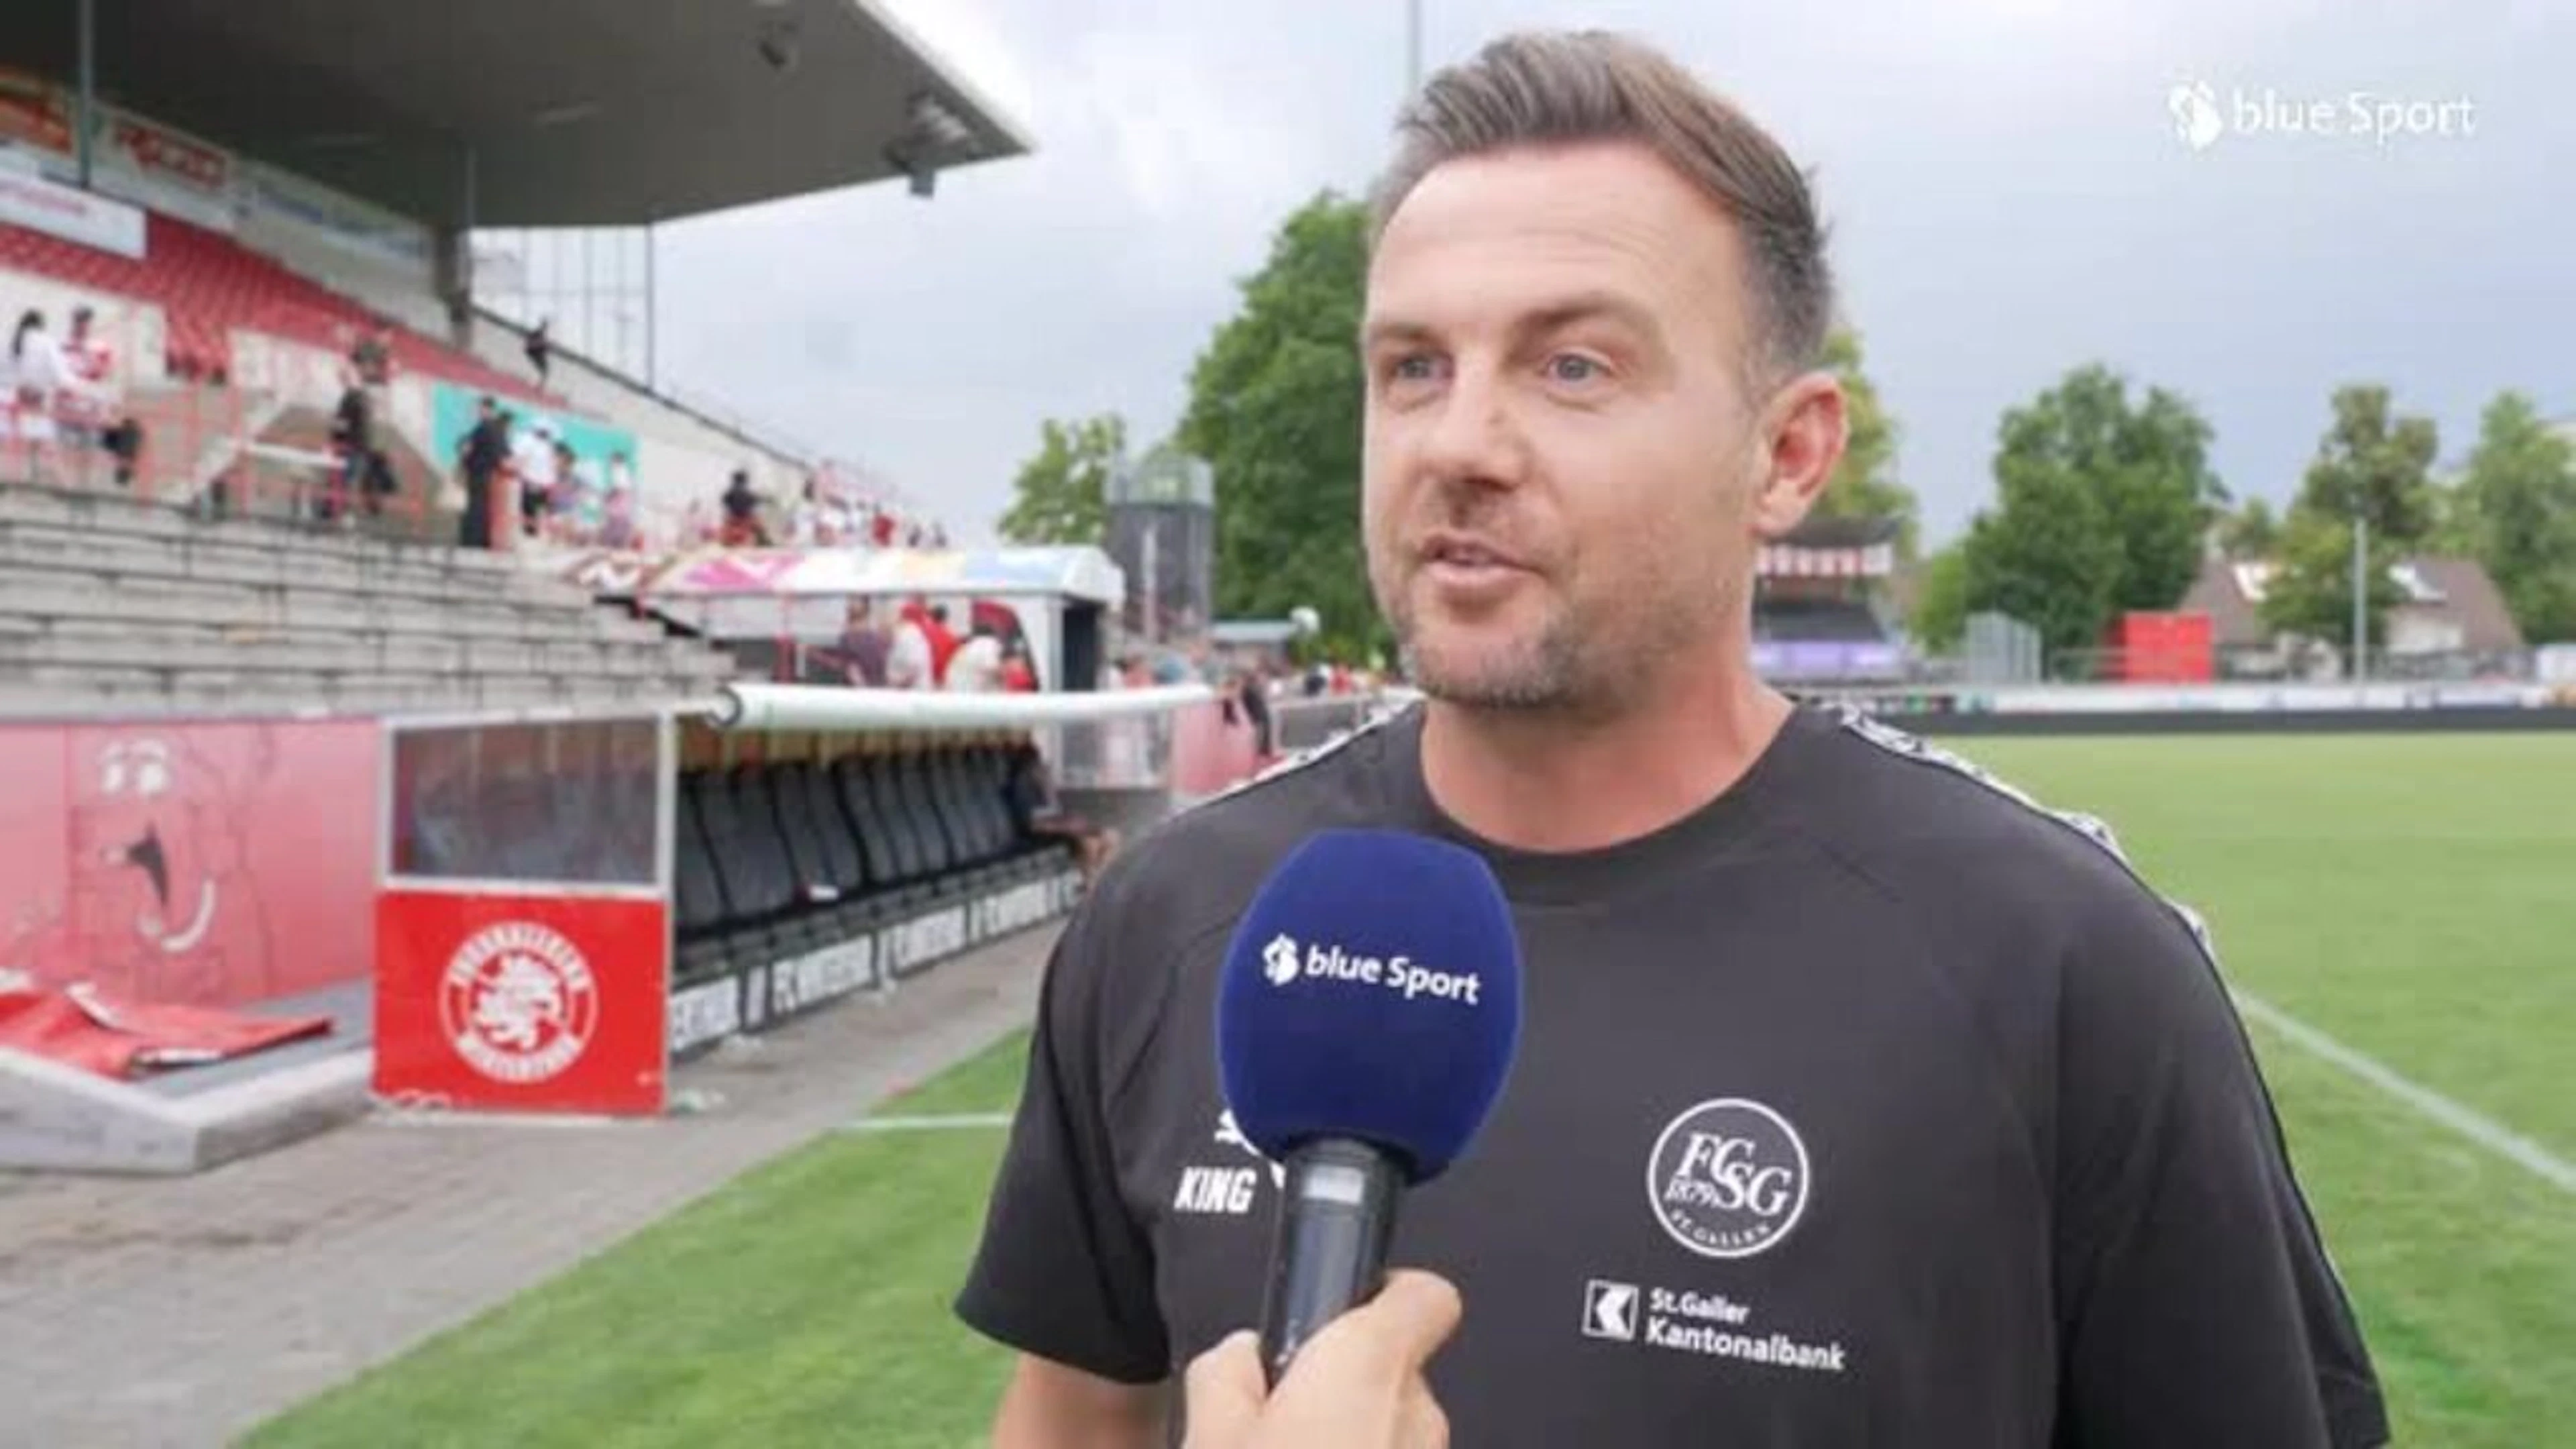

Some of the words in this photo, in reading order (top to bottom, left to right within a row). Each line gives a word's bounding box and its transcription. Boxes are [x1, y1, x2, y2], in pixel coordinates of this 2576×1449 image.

[1305, 945, 1381, 982] blue
[1387, 957, 1481, 1005] Sport
[1173, 1167, 1256, 1213] KING
[1646, 1316, 1846, 1370] Kantonalbank
